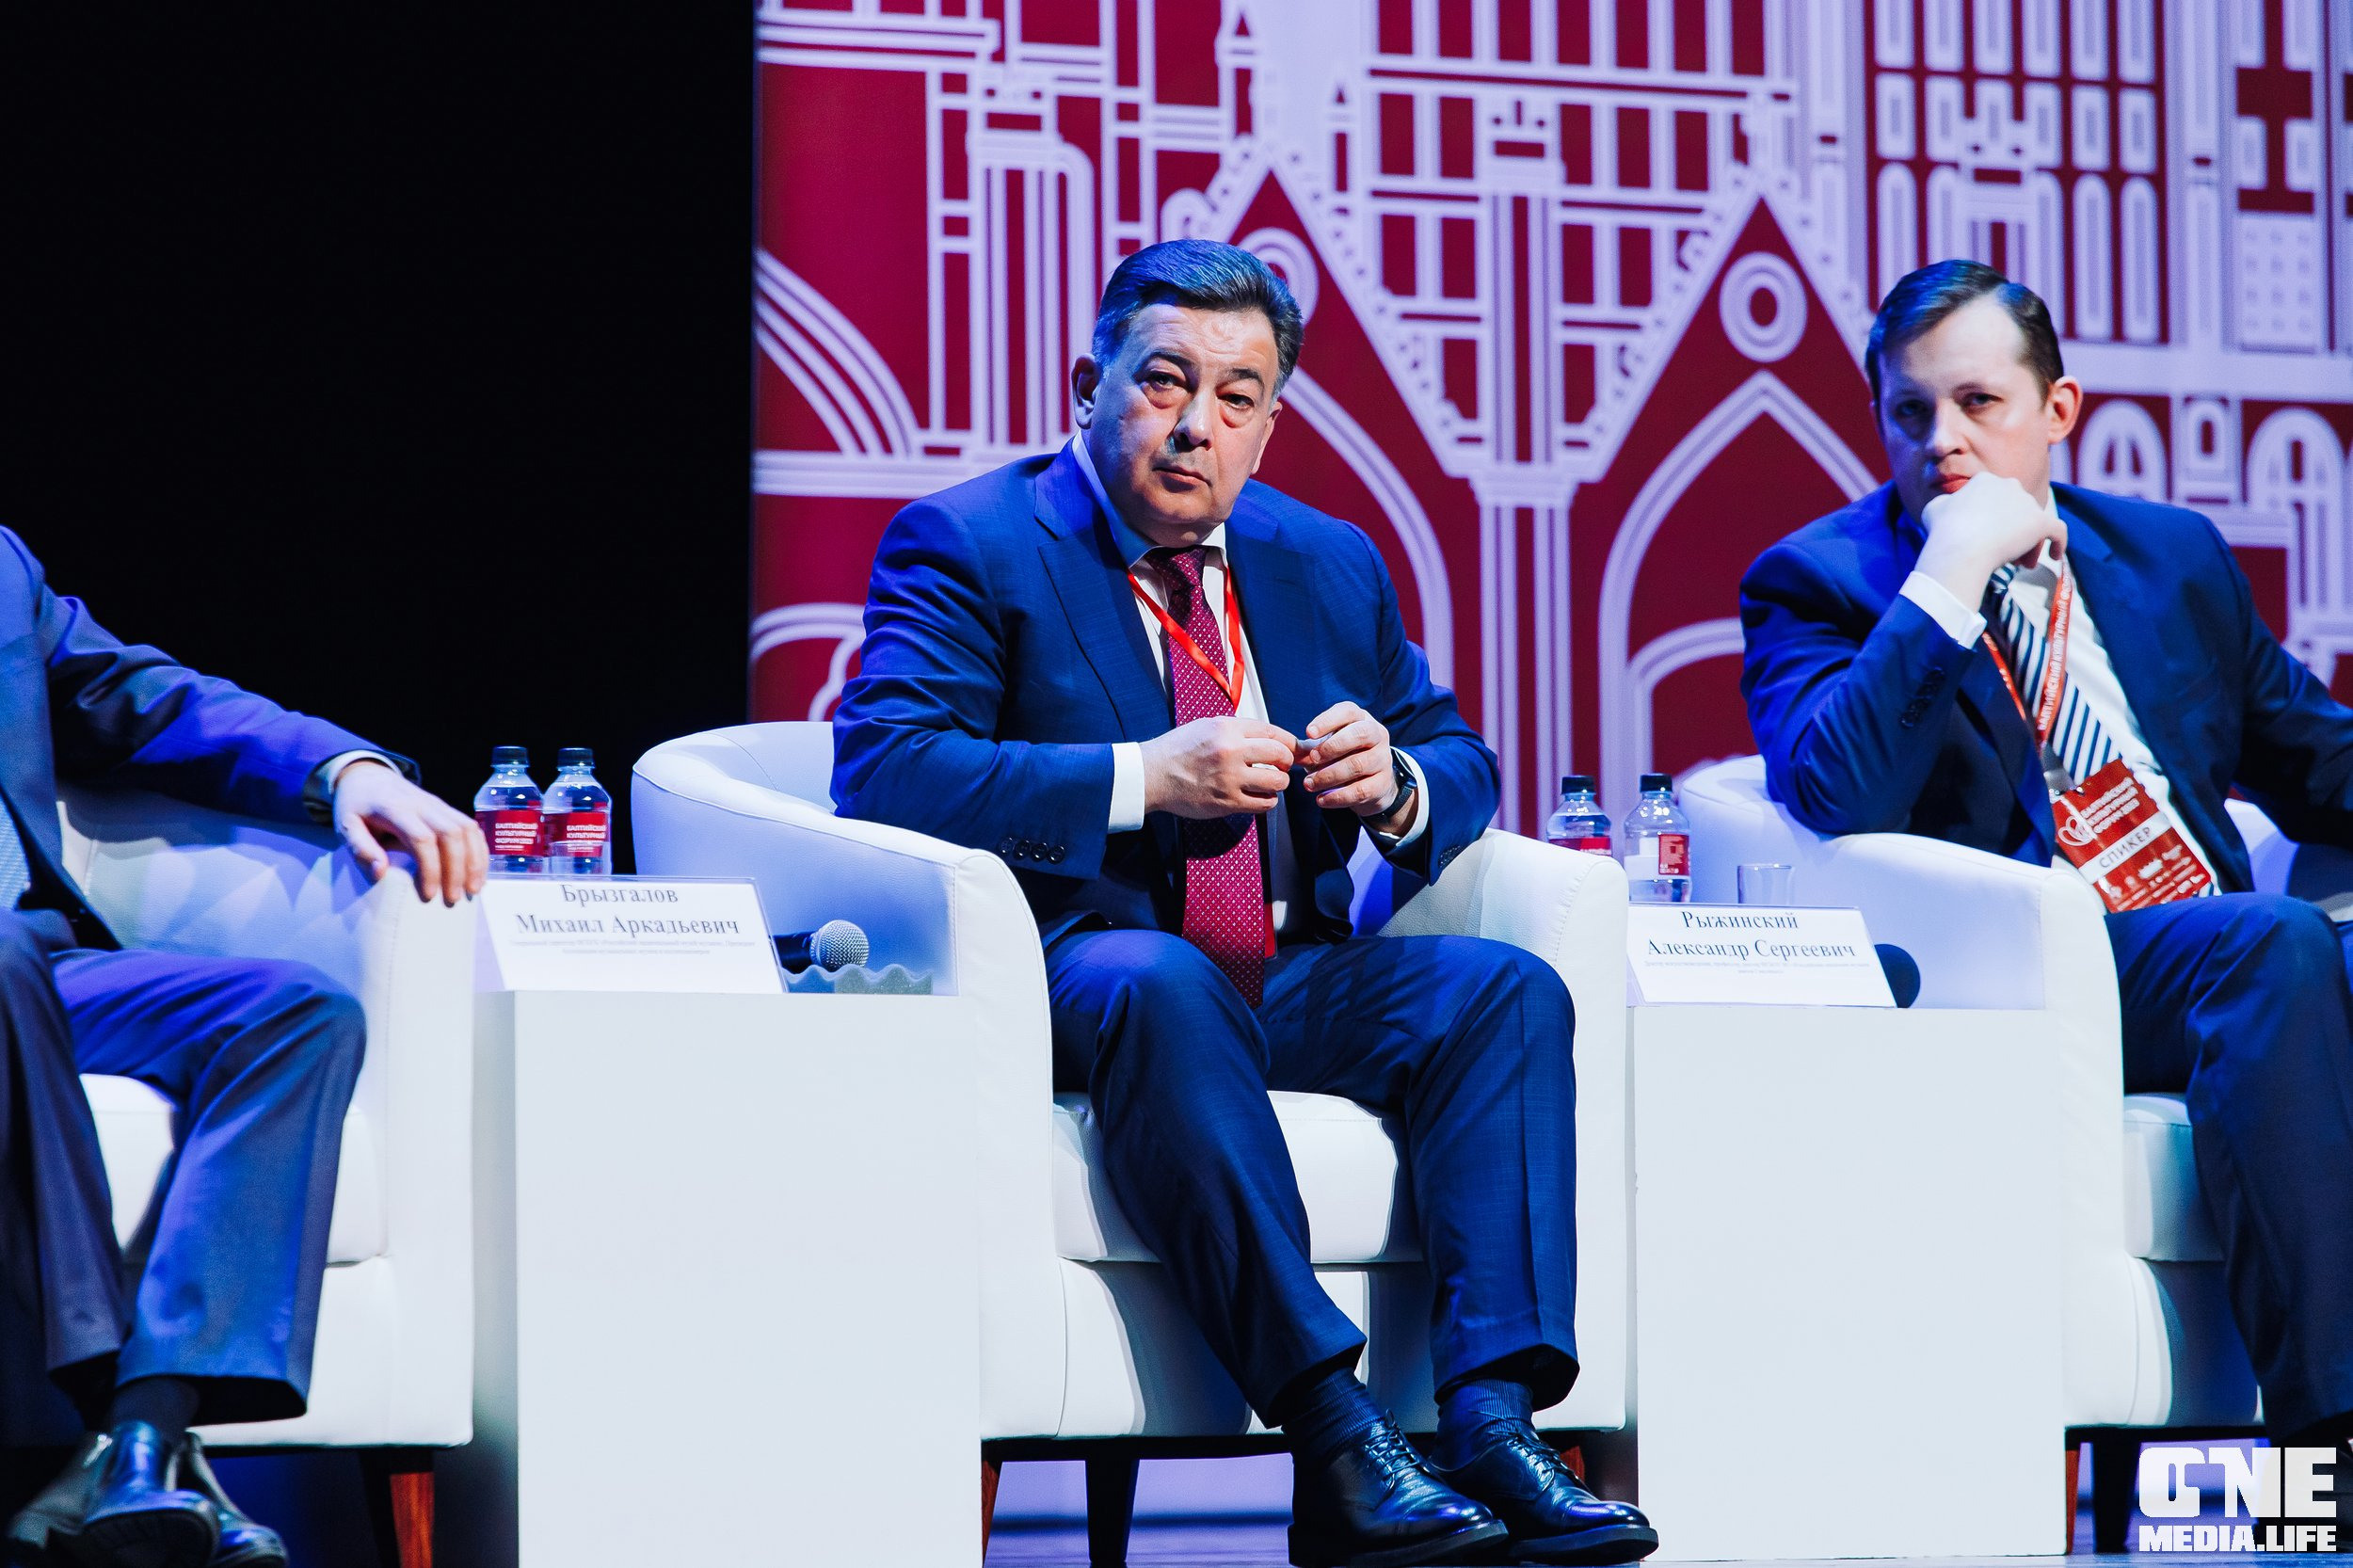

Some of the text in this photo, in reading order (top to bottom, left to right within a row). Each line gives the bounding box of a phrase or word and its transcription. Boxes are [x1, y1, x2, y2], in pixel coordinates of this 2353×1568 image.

[2099, 826, 2150, 868] СПИКЕР
[560, 884, 679, 906] Брызгалов
[516, 914, 740, 938] Михаил Аркадьевич
[1681, 911, 1800, 929] Рыжинский
[1648, 938, 1856, 961] Александр Сергеевич
